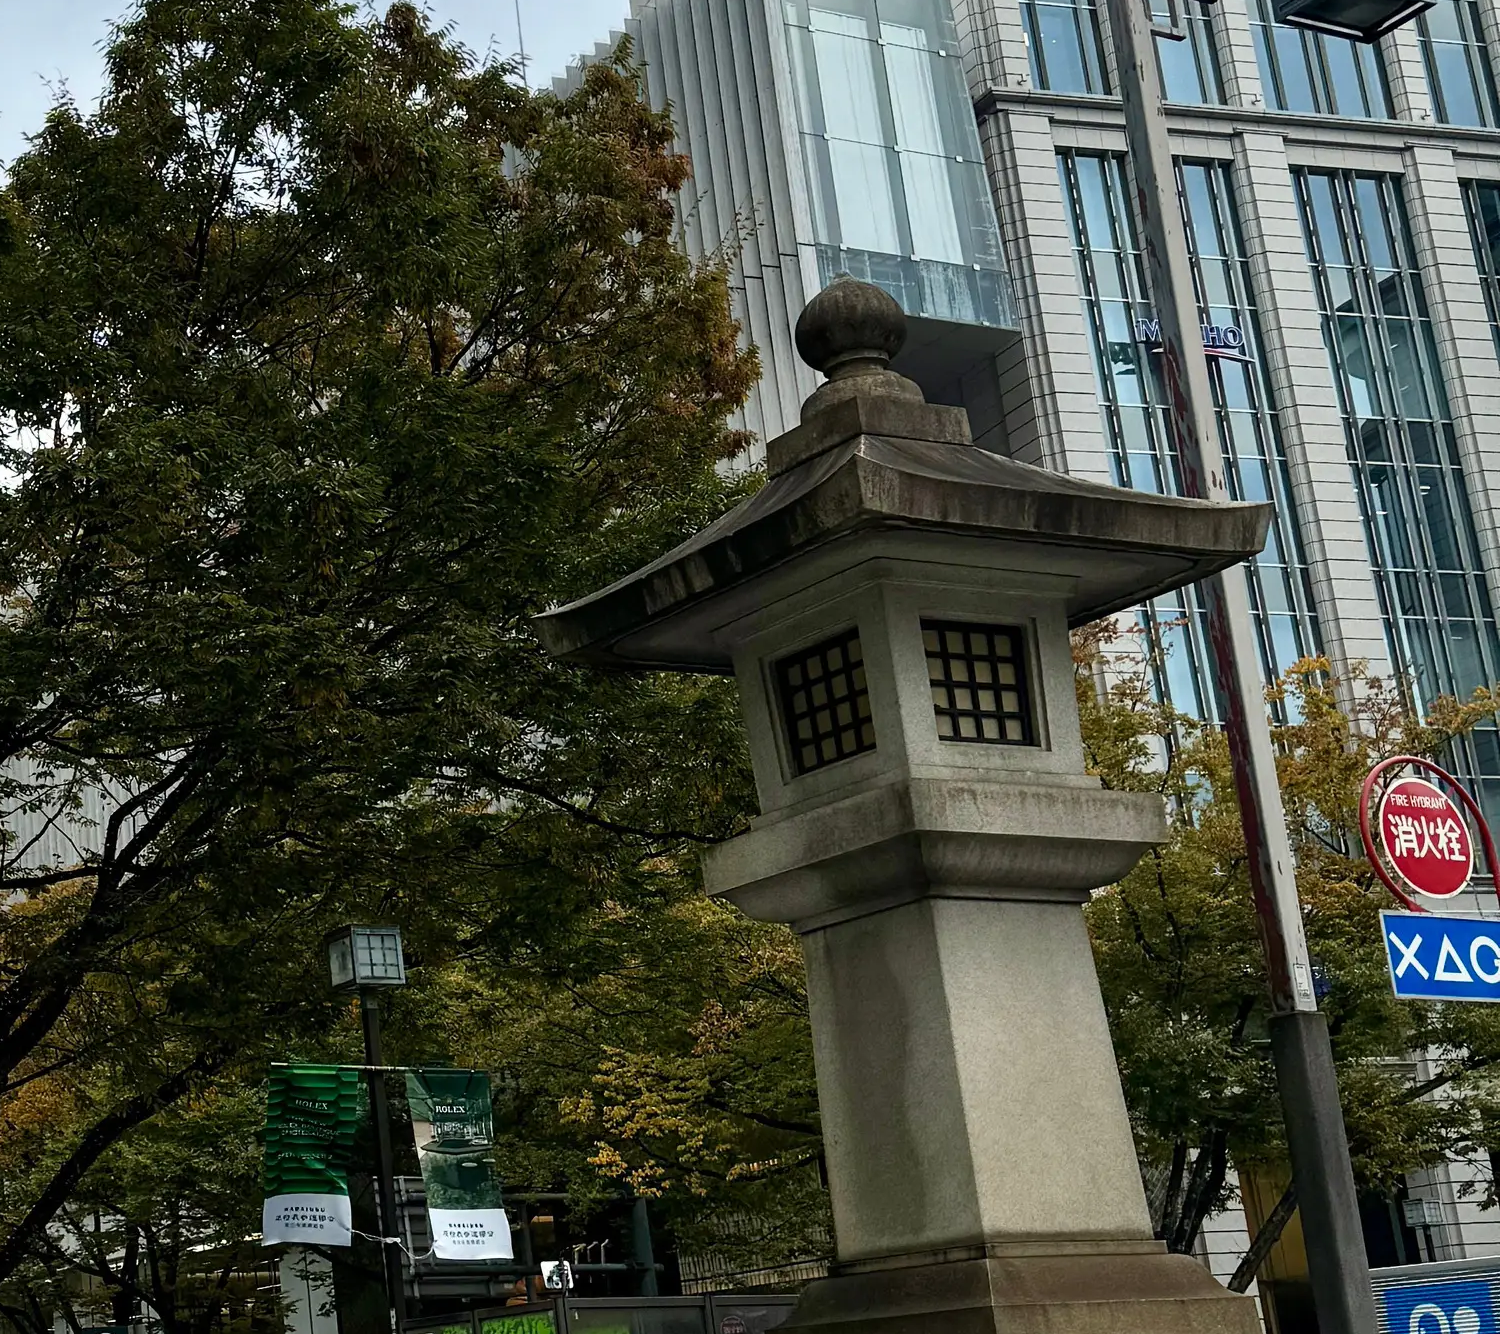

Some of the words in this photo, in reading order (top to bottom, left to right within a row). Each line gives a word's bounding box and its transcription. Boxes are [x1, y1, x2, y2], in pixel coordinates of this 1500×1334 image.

[1389, 793, 1409, 807] FIRE
[1409, 794, 1448, 810] HYDRANT
[1388, 813, 1466, 861] 消火栓
[435, 1105, 466, 1113] ROLEX
